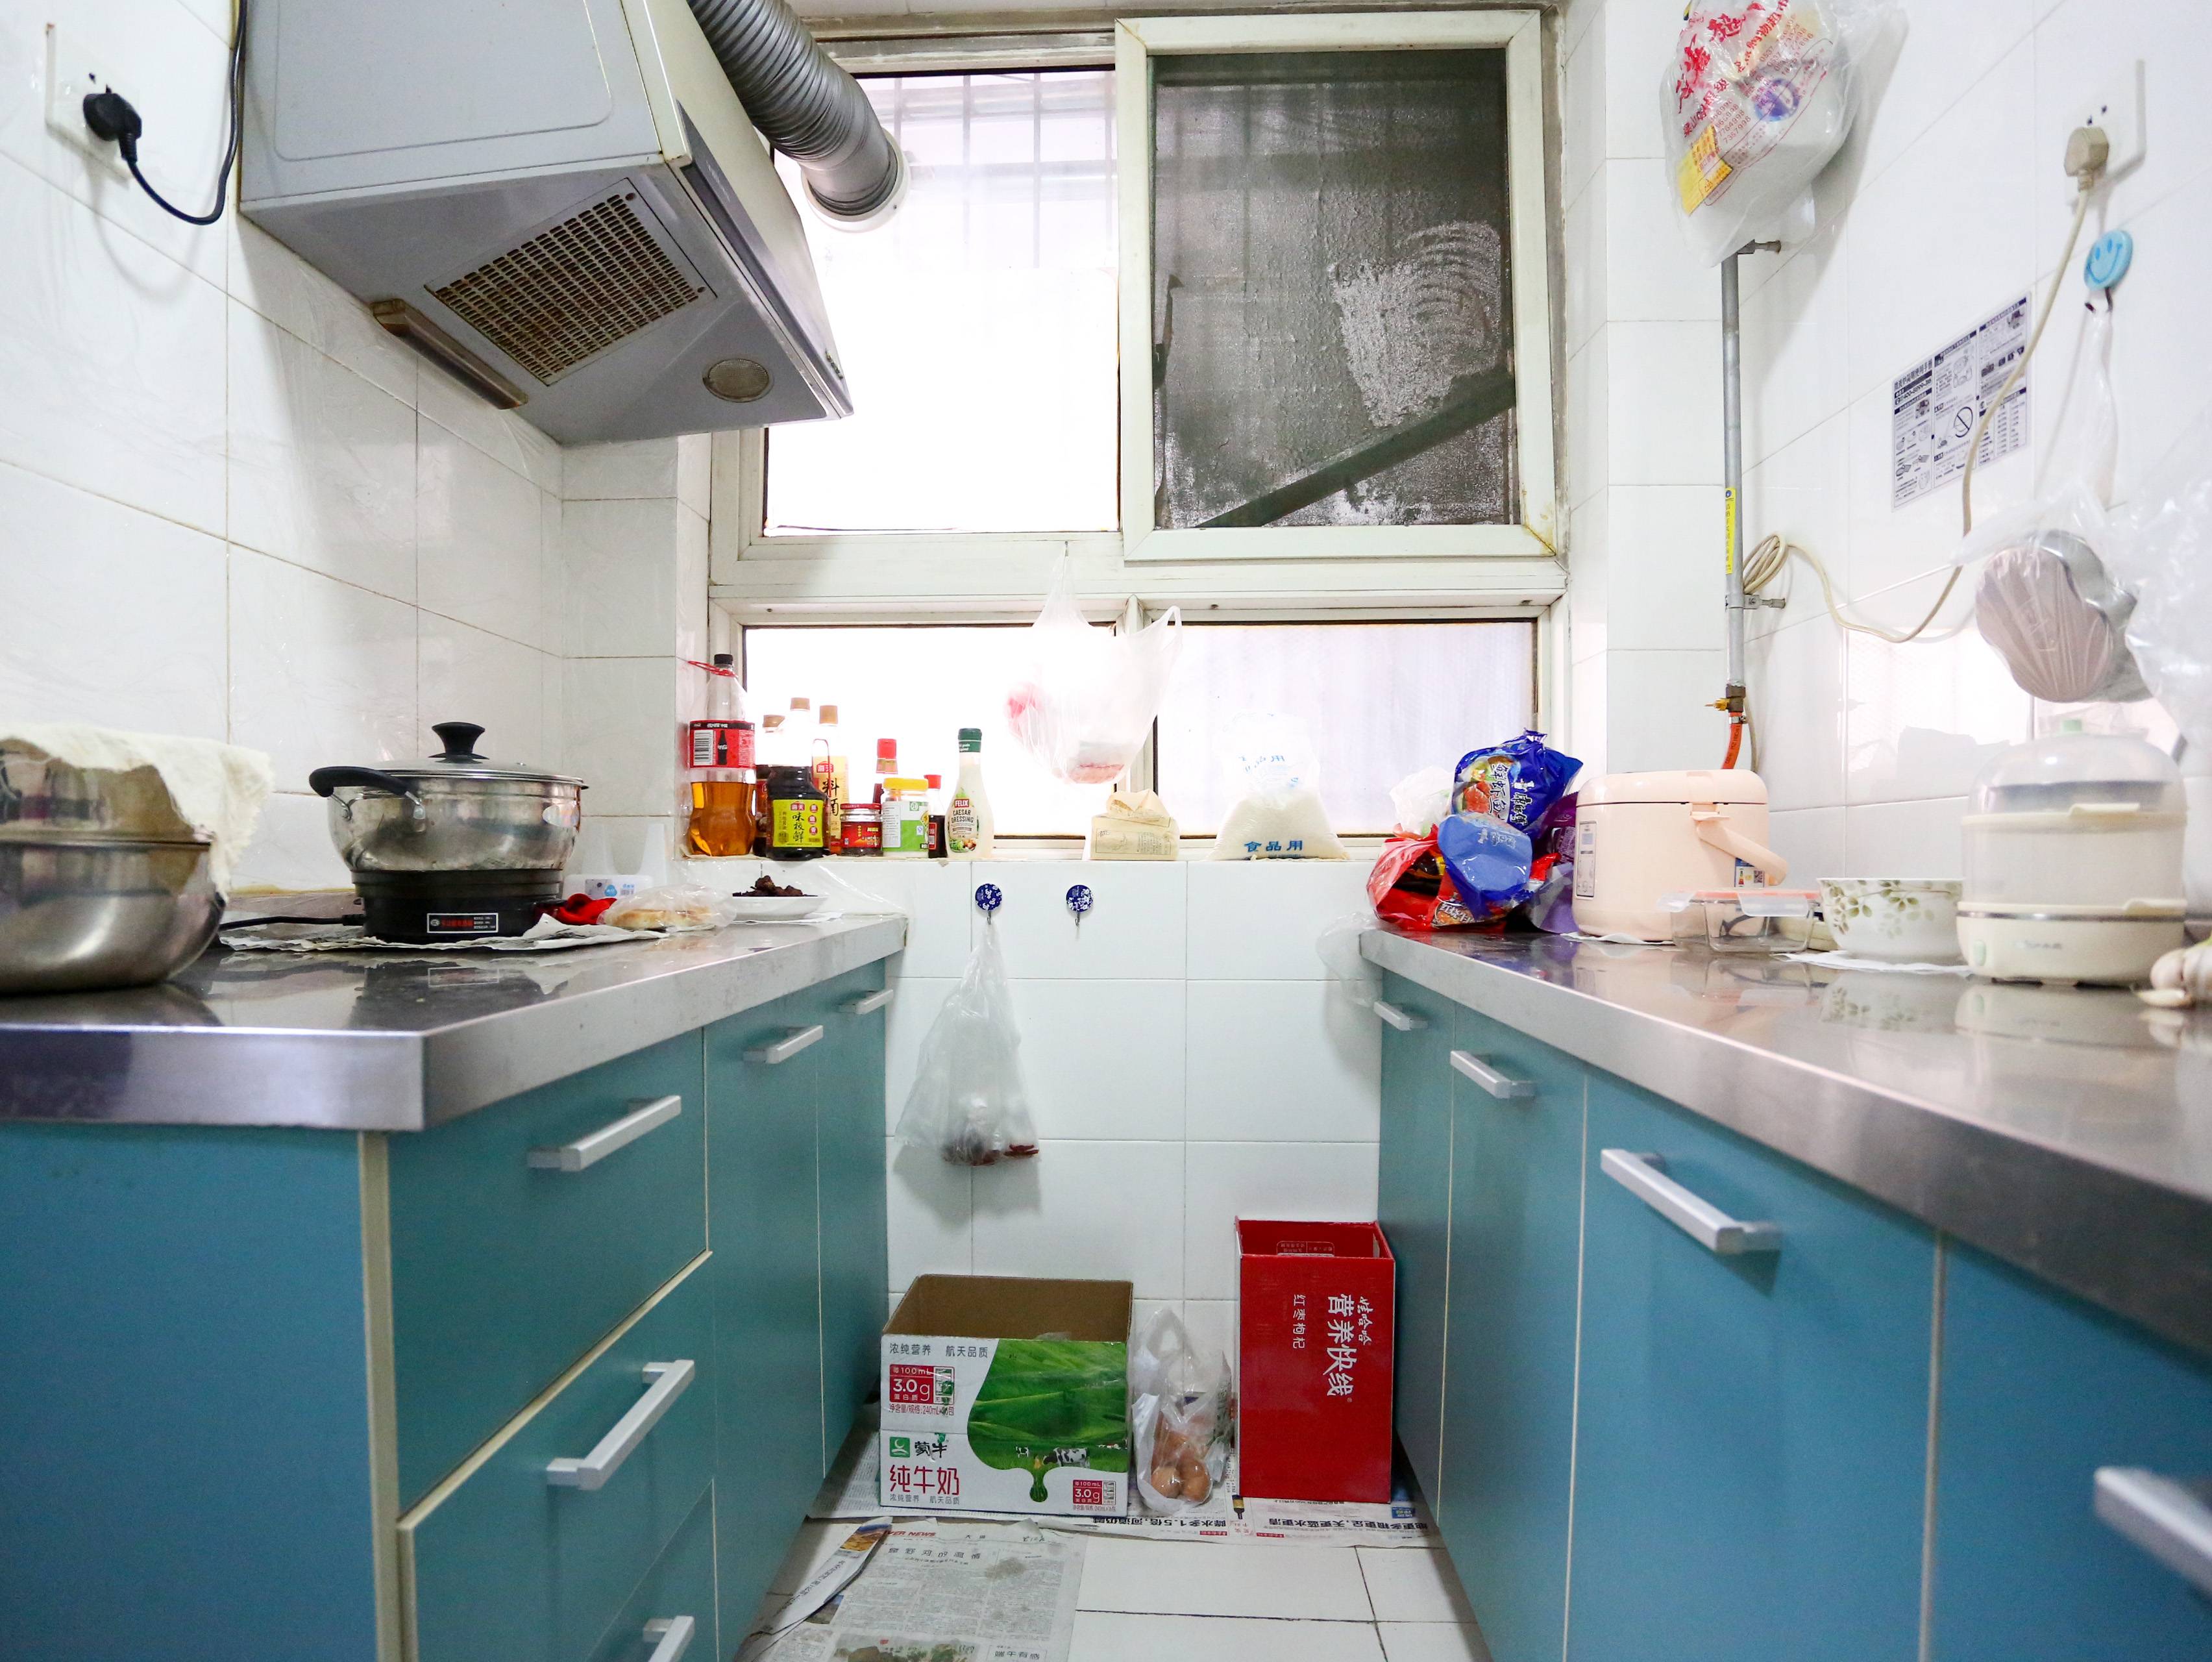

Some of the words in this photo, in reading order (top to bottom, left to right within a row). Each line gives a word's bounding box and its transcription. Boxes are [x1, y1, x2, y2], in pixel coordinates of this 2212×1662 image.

[1488, 763, 1509, 821] 鲜虾鱼
[1244, 840, 1303, 853] 食品用
[1293, 1294, 1306, 1349] 红枣枸杞
[1357, 1296, 1373, 1346] 娃哈哈
[889, 1343, 931, 1356] 浓纯营养
[946, 1345, 988, 1358] 航天品质
[1323, 1293, 1358, 1396] 营养快线
[915, 1441, 947, 1458] 蒙牛
[890, 1464, 959, 1495] 纯牛奶
[929, 1496, 960, 1505] 航天品质
